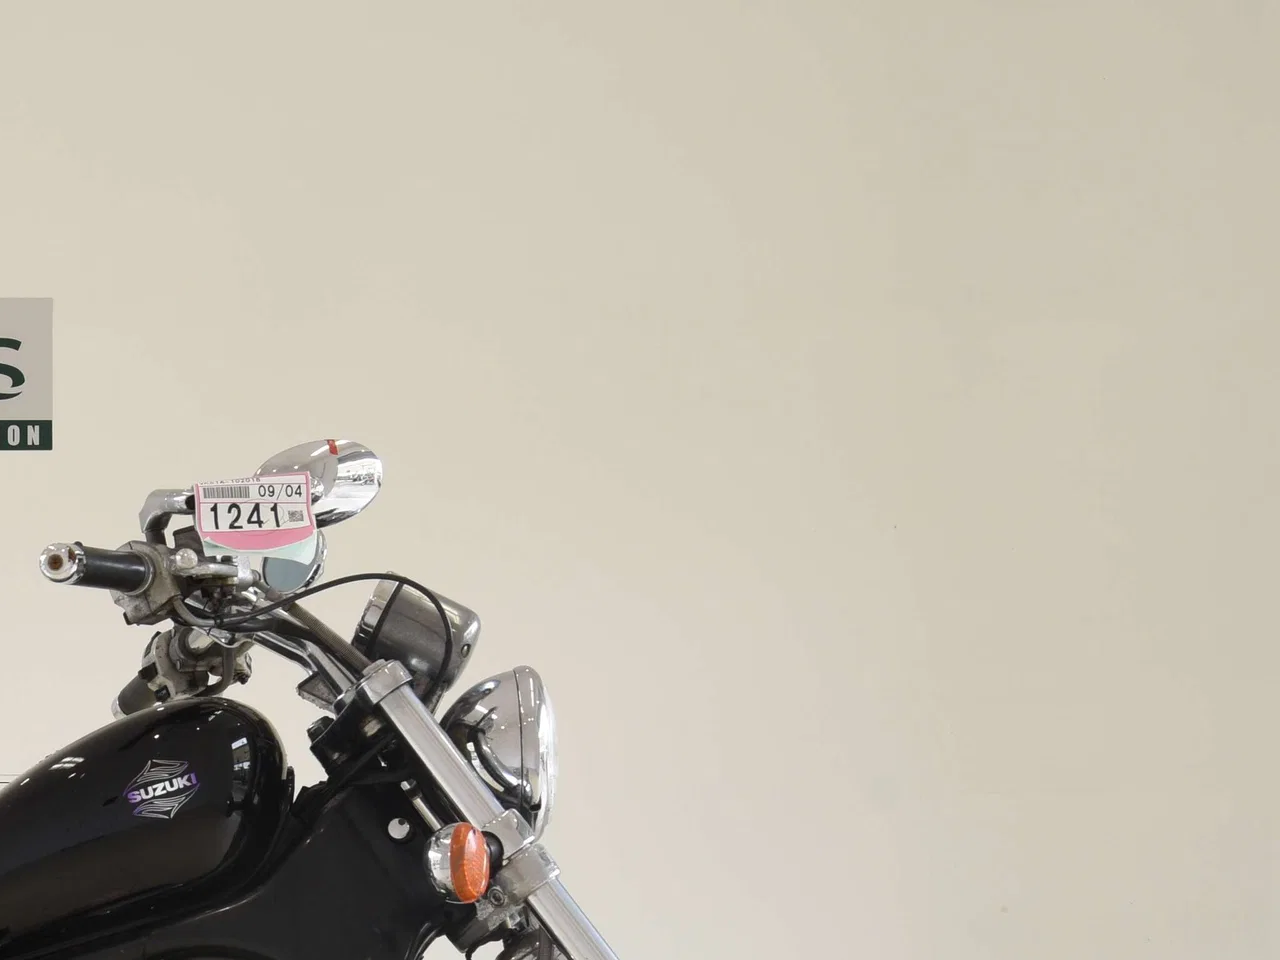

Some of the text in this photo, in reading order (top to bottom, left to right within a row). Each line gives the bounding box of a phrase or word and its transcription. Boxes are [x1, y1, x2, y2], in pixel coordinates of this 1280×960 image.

[258, 484, 303, 500] 09/04
[210, 502, 281, 530] 1241
[127, 772, 198, 803] SUZUKI
